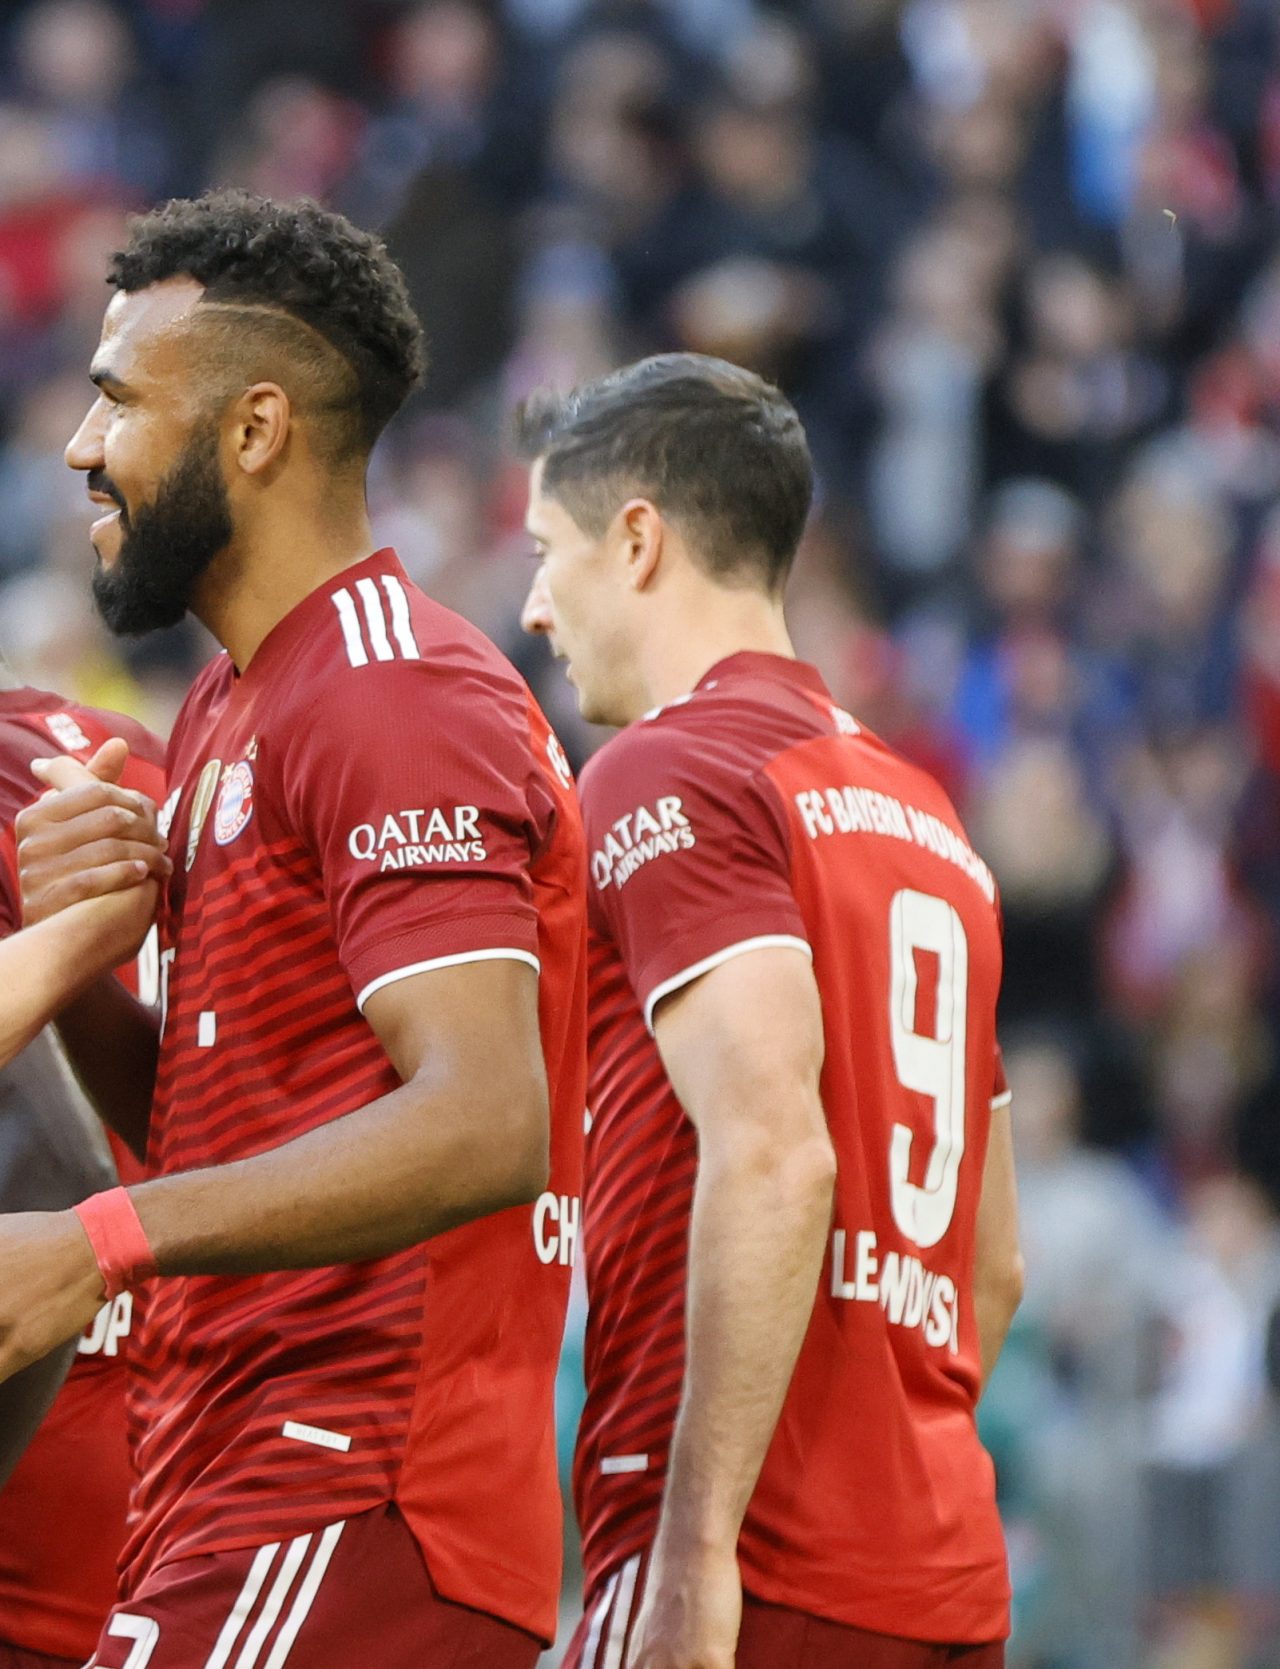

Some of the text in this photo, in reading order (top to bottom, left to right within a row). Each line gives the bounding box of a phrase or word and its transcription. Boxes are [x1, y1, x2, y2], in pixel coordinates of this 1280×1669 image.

[348, 805, 482, 861] QATAR
[795, 788, 834, 840] FC
[380, 840, 487, 872] AIRWAYS
[591, 795, 690, 891] QATAR
[888, 888, 968, 1248] 9
